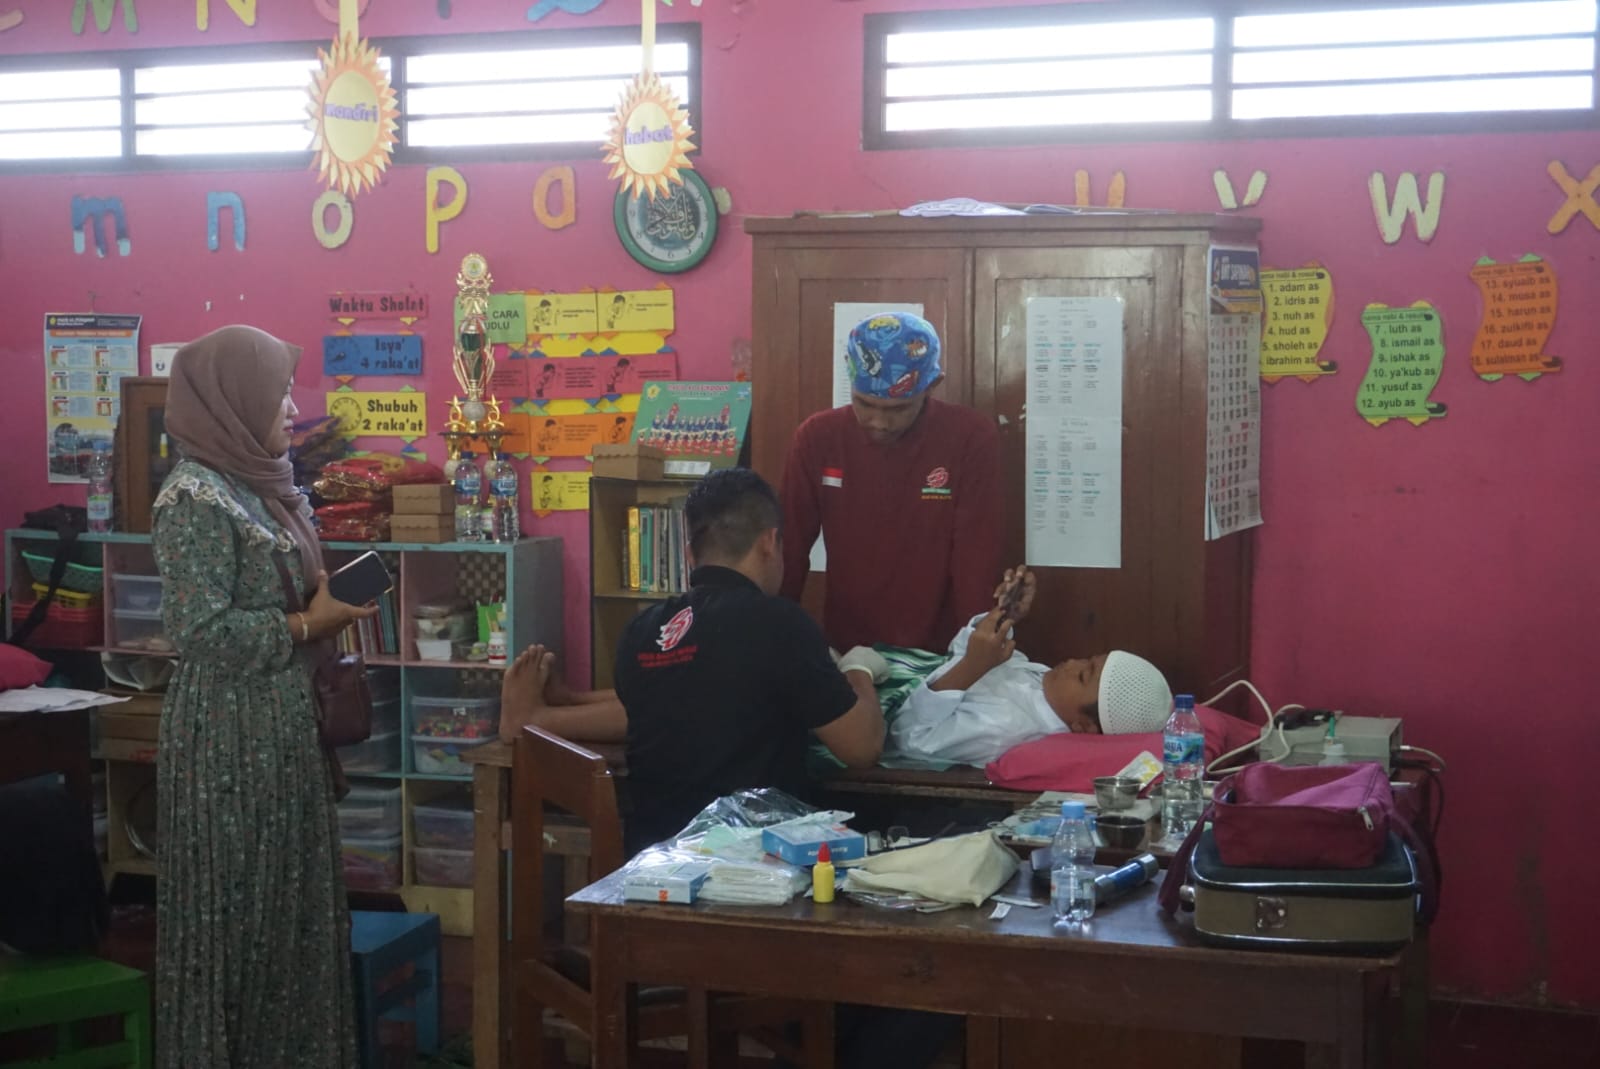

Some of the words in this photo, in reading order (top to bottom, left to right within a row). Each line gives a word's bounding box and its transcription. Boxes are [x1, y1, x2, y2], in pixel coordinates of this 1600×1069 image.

[72, 195, 131, 258] m
[207, 191, 247, 252] n
[312, 190, 354, 249] o
[425, 166, 468, 253] p
[1539, 276, 1551, 284] as
[1269, 283, 1277, 293] 1.
[1279, 283, 1306, 292] adam
[1308, 283, 1320, 291] as
[1273, 296, 1282, 306] 2.
[1285, 296, 1306, 305] idris
[1308, 296, 1320, 304] as
[1509, 291, 1536, 301] musa
[1539, 290, 1551, 299] as
[329, 297, 374, 313] Waktu
[1507, 307, 1537, 316] harun
[1539, 305, 1551, 314] as
[493, 310, 519, 320] CARA
[1272, 311, 1280, 321] 3.
[1283, 310, 1302, 320] nuh
[1304, 311, 1315, 319] as
[485, 320, 511, 331] UDLU
[1267, 327, 1276, 336] 4.
[1278, 326, 1297, 336] hud
[1299, 326, 1311, 334] as
[1389, 324, 1408, 333] luth
[1411, 325, 1422, 333] as
[1537, 322, 1549, 330] as
[1273, 341, 1305, 350] sholeh
[1307, 341, 1319, 349] as
[1380, 338, 1389, 348] 8.
[1391, 338, 1421, 347] ismail
[1423, 338, 1435, 346] as
[1498, 338, 1523, 349] daud
[1525, 338, 1537, 346] as
[360, 357, 370, 369] 4
[1266, 356, 1302, 366] ibrahim
[1304, 356, 1316, 364] as
[1378, 353, 1388, 363] 9.
[1390, 353, 1417, 363] ishak
[1419, 353, 1430, 361] as
[1373, 368, 1387, 378] 10.
[1390, 367, 1422, 379] ya'kub
[1424, 368, 1436, 376] as
[1366, 383, 1379, 392] 11.
[1381, 382, 1409, 393] yusuf
[1411, 383, 1423, 391] as
[367, 399, 418, 413] Shubuh
[1361, 399, 1375, 408] 12.
[1377, 398, 1402, 410] ayub
[1404, 399, 1416, 407] as
[362, 418, 372, 431] 2
[376, 416, 424, 432] raka'at
